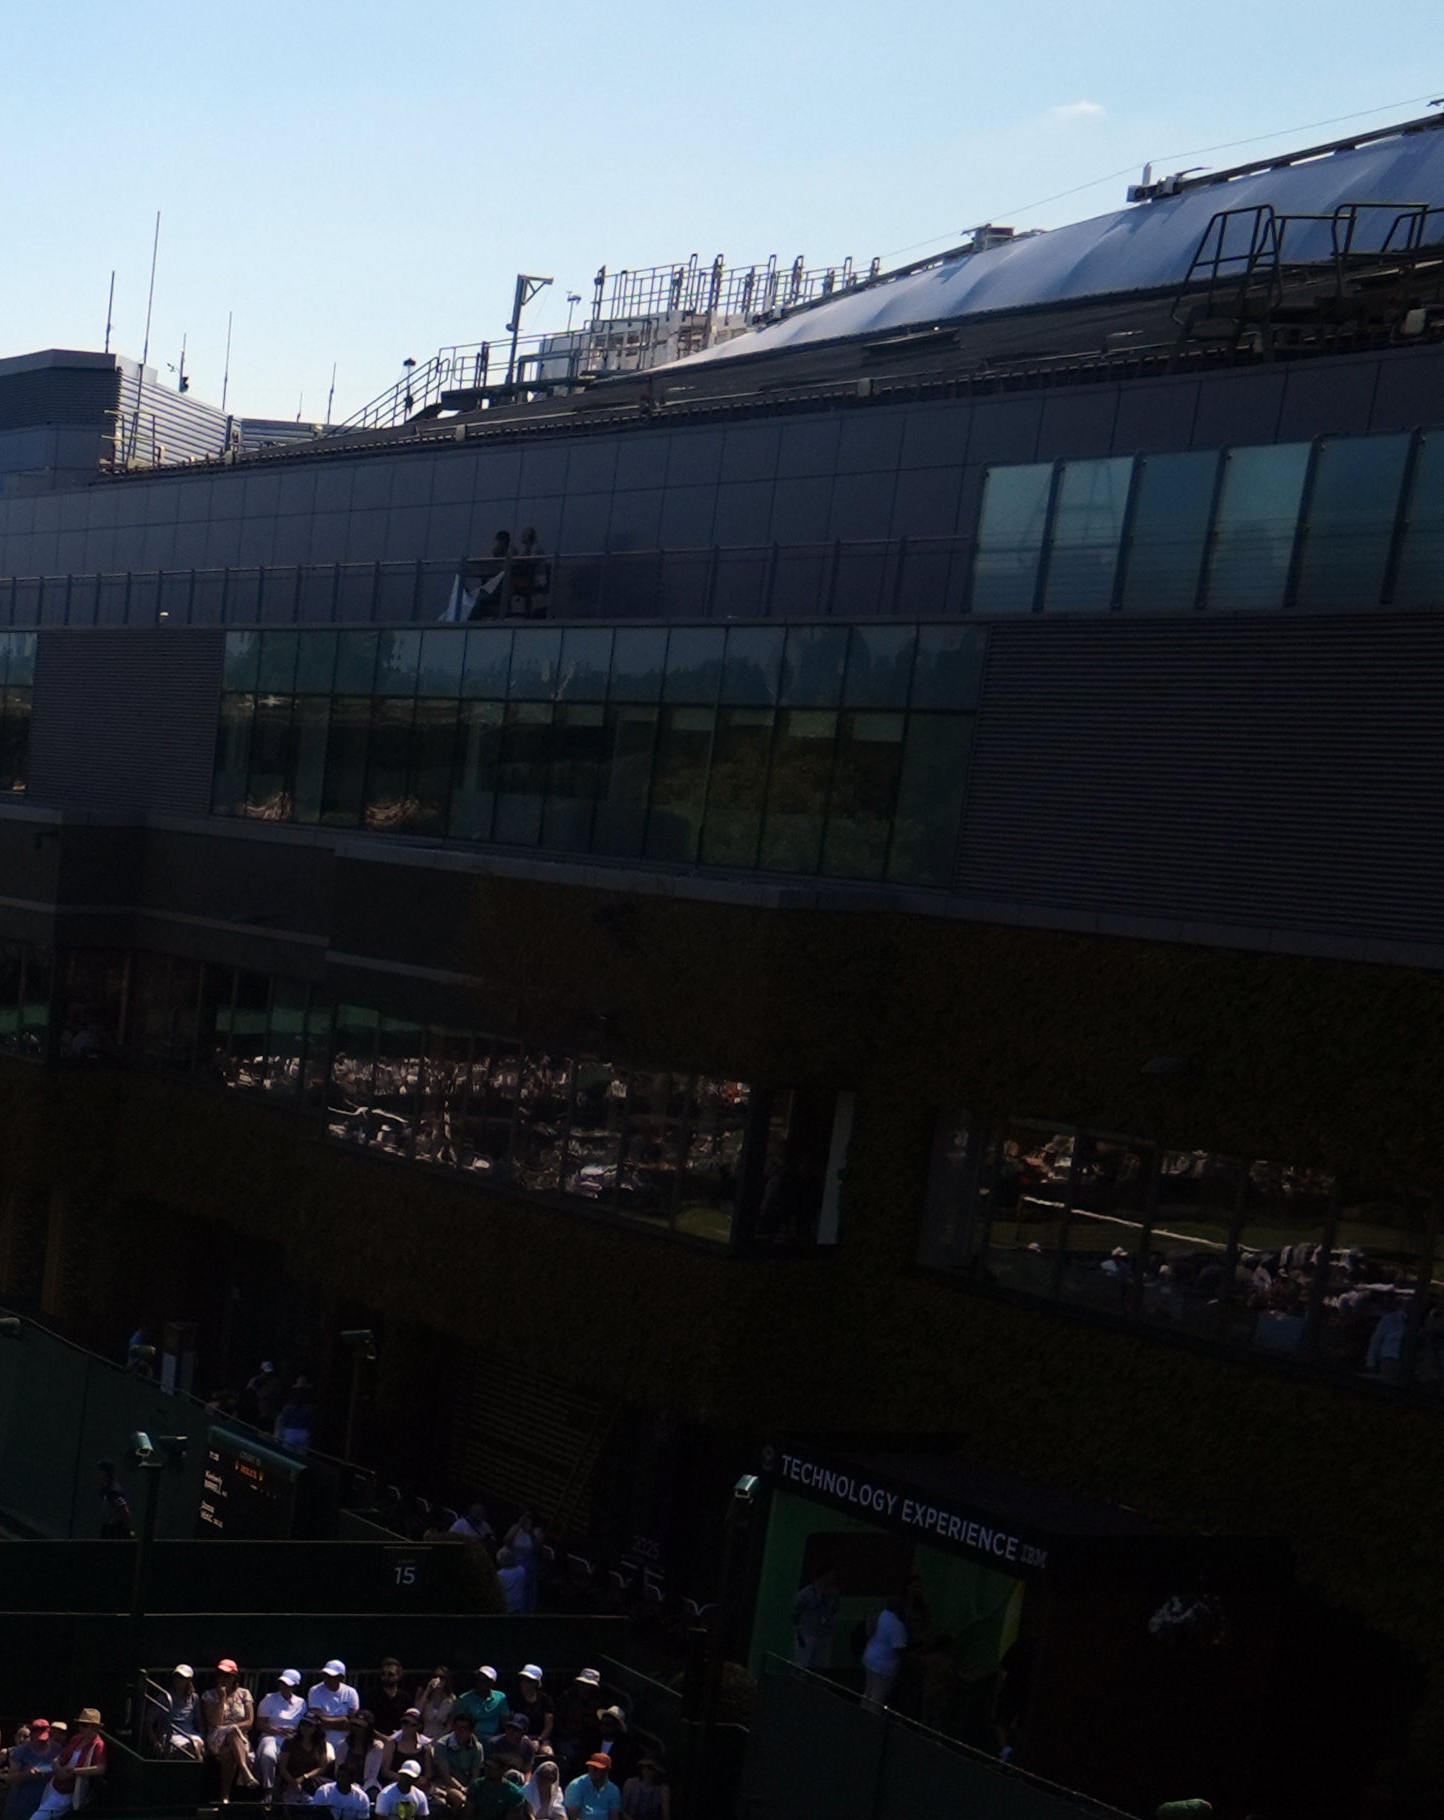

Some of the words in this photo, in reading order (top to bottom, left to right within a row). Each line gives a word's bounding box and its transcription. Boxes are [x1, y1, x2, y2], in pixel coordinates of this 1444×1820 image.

[781, 1454, 899, 1516] TECHNOLOGY
[901, 1499, 1020, 1562] EXPERIENCE
[1020, 1544, 1047, 1569] IBM
[394, 1566, 416, 1585] 15
